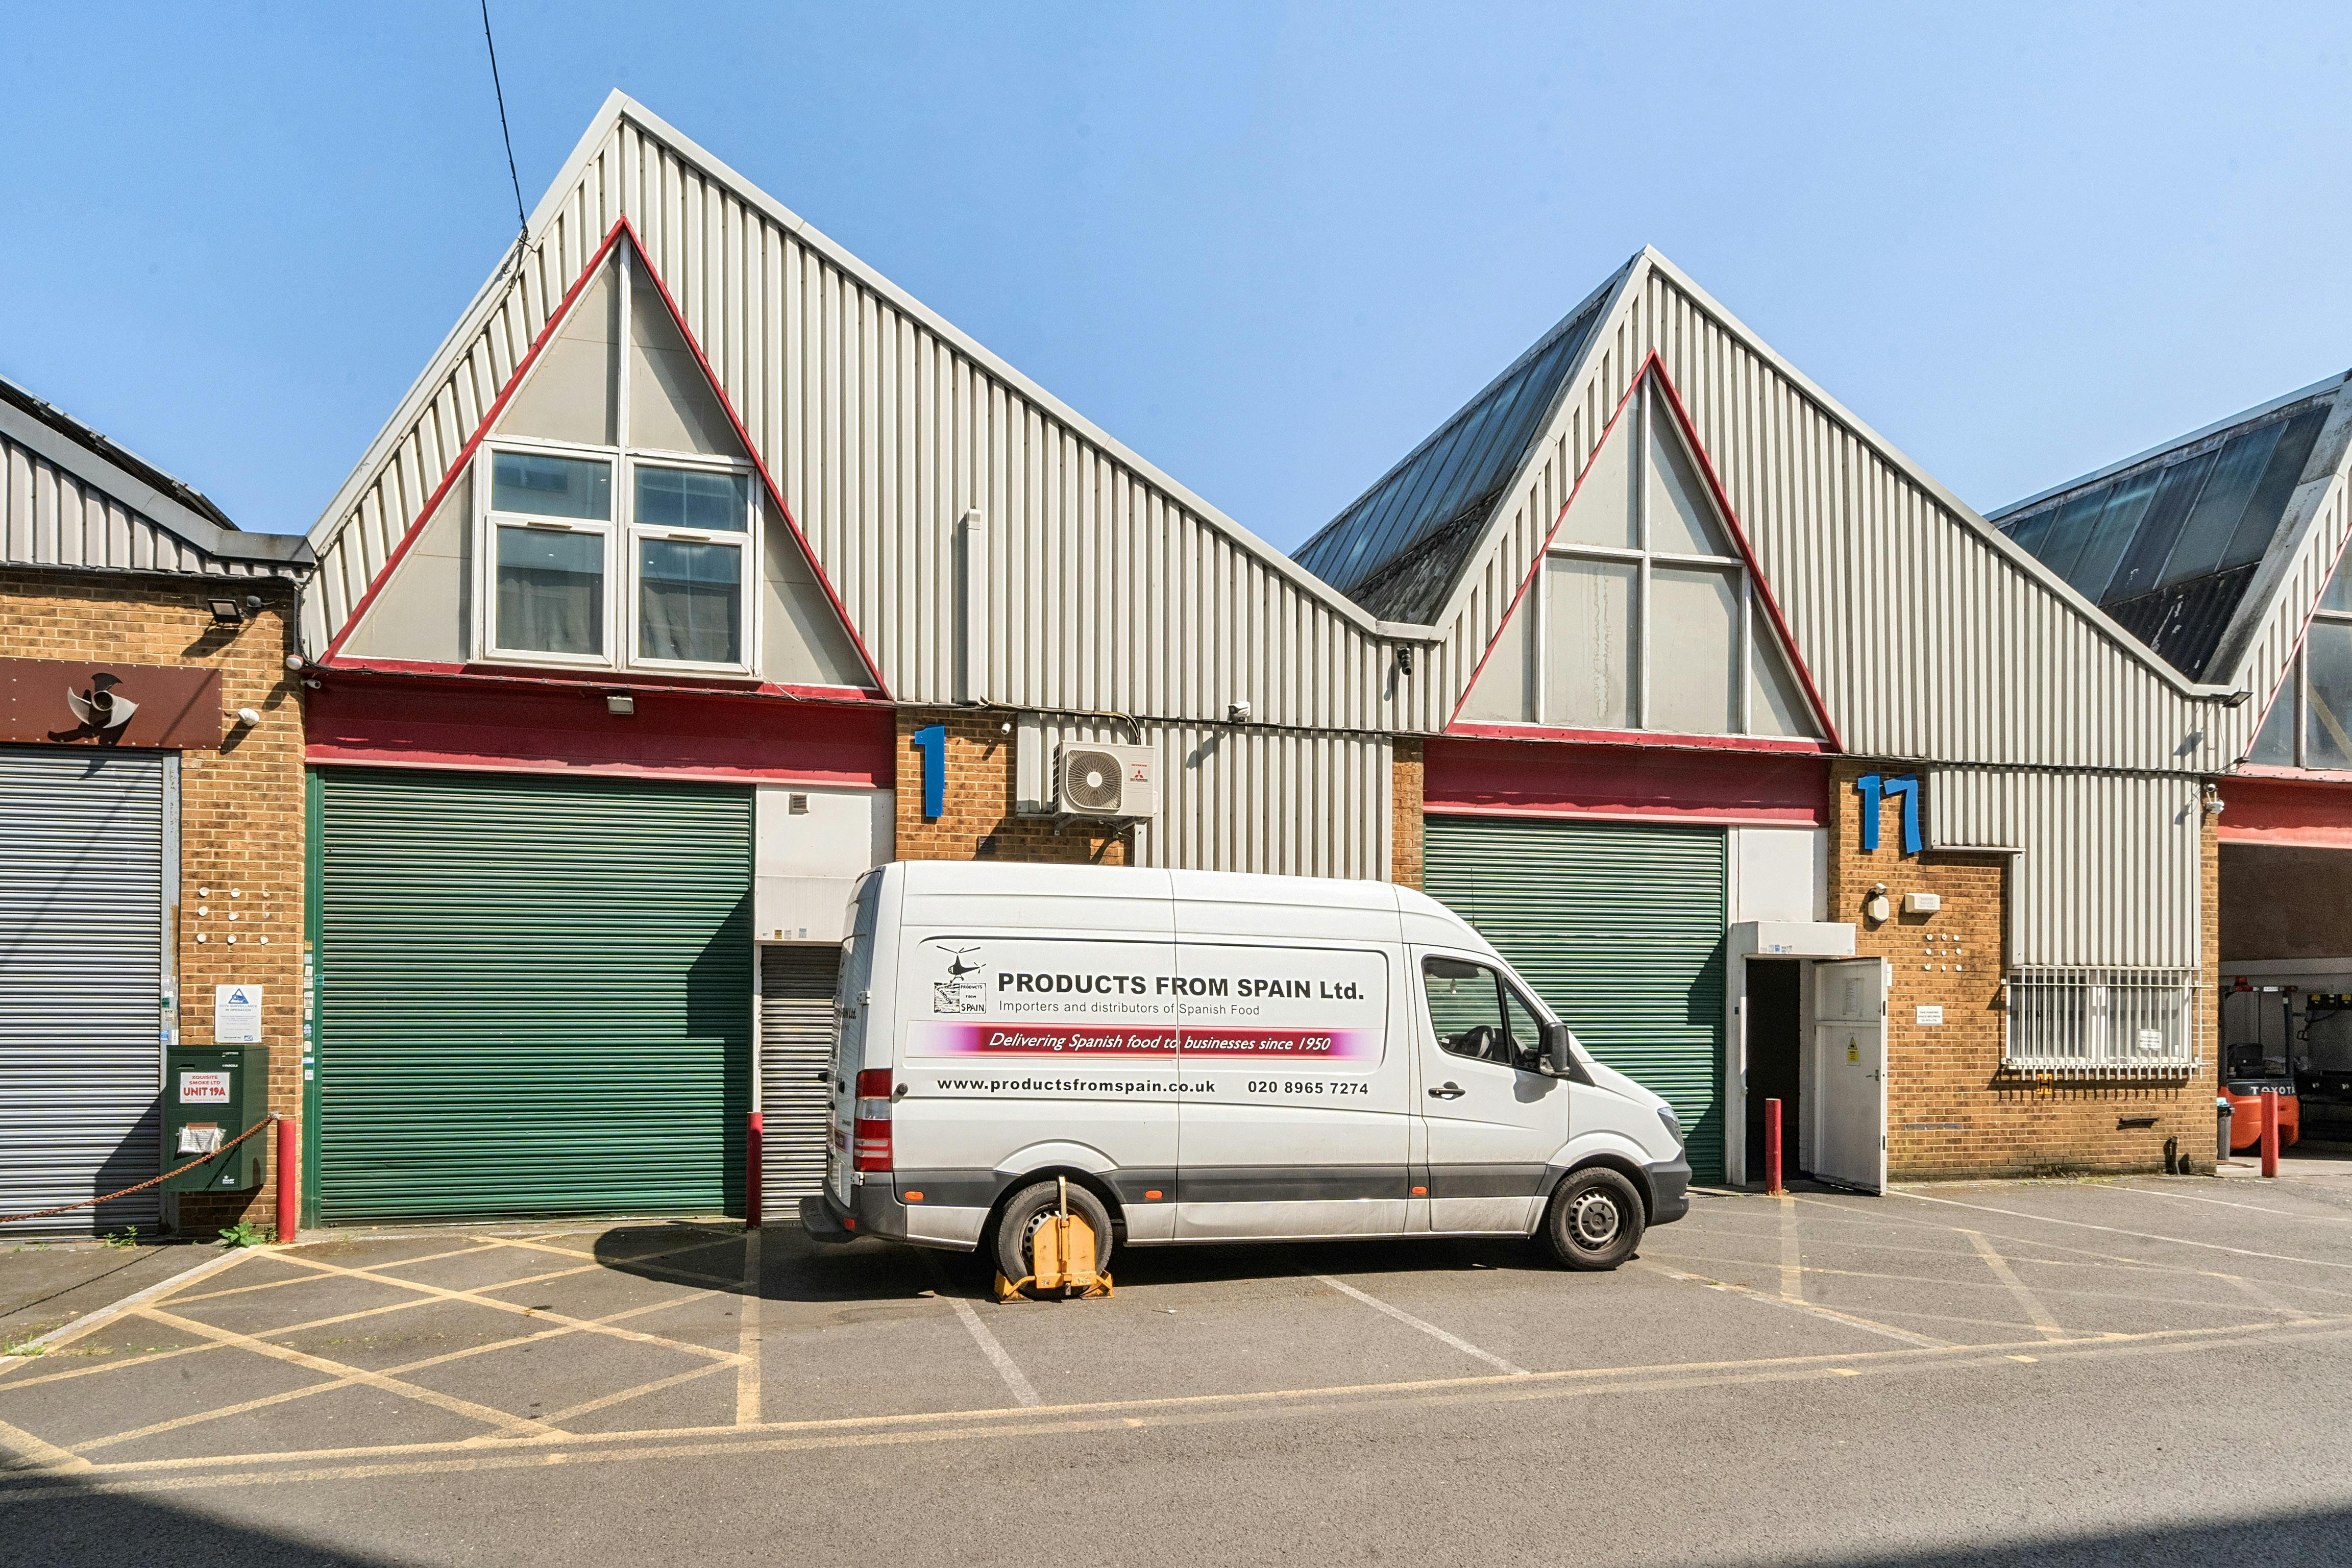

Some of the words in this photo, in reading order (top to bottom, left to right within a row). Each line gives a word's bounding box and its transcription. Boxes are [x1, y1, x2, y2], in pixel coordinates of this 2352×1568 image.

[915, 725, 945, 817] 1
[1858, 772, 1922, 854] 17
[998, 973, 1146, 994] PRODUCTS
[1156, 977, 1229, 996] FROM
[1237, 978, 1311, 998] SPAIN
[1320, 981, 1364, 999] Ltd.
[961, 1003, 985, 1012] SPAIN
[1000, 1000, 1059, 1013] Importers
[1064, 1002, 1086, 1012] and
[1091, 1002, 1159, 1013] distributors
[1164, 1003, 1174, 1013] of
[1179, 1003, 1226, 1016] Spanish
[1231, 1004, 1259, 1015] Food
[989, 1032, 1067, 1051] Delivering
[1068, 1034, 1123, 1051] Spanish
[1126, 1035, 1162, 1048] food
[1164, 1037, 1180, 1049] to
[1184, 1036, 1256, 1049] businesses
[1259, 1037, 1293, 1050] since
[1298, 1037, 1331, 1051] 1950
[183, 1087, 208, 1096] UNIT
[209, 1087, 226, 1096] 19A
[937, 1077, 1216, 1094] www.productsfromspain.co.uk
[1248, 1081, 1277, 1093] 020
[1284, 1082, 1323, 1094] 8965
[1330, 1083, 1368, 1094] 7274
[2250, 1086, 2296, 1095] TOYOTA
